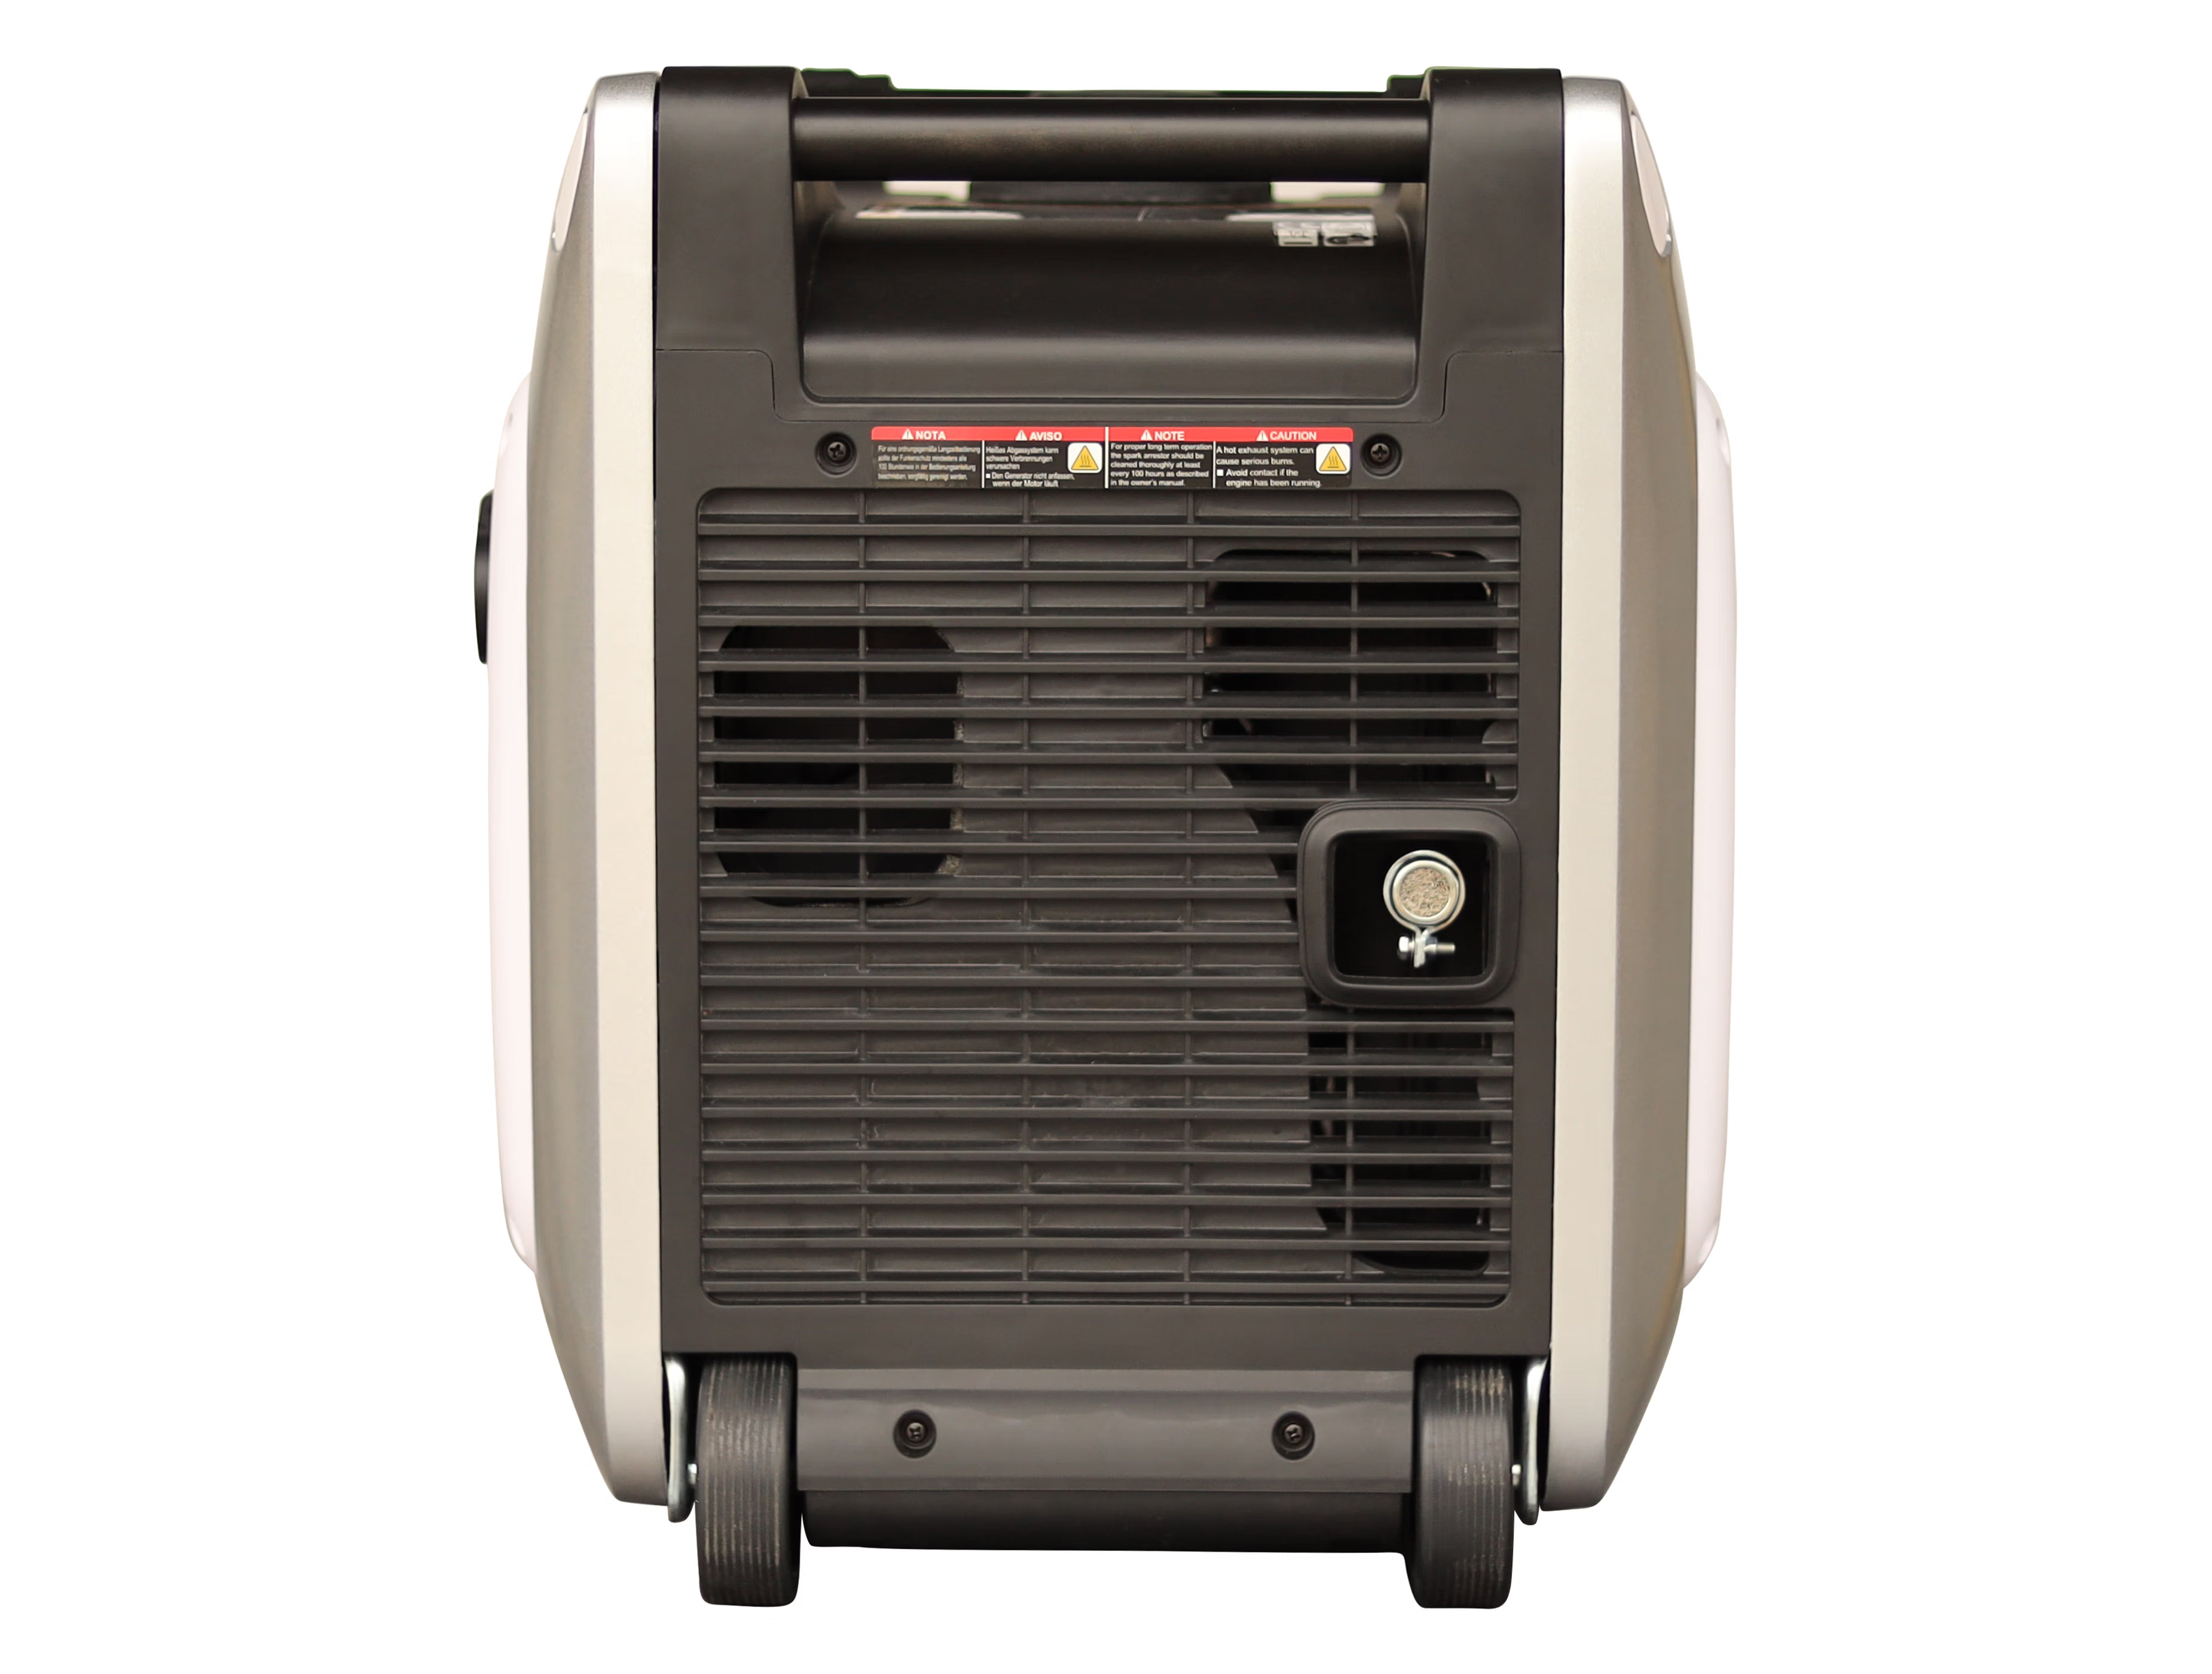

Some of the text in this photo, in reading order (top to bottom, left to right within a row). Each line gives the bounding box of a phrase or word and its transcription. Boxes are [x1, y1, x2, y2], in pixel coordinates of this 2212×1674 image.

[916, 431, 946, 440] NOTA
[1029, 432, 1062, 441] AVISO
[1154, 431, 1184, 440] NOTE
[1270, 431, 1316, 440] CAUTION
[1291, 479, 1322, 488] running.
